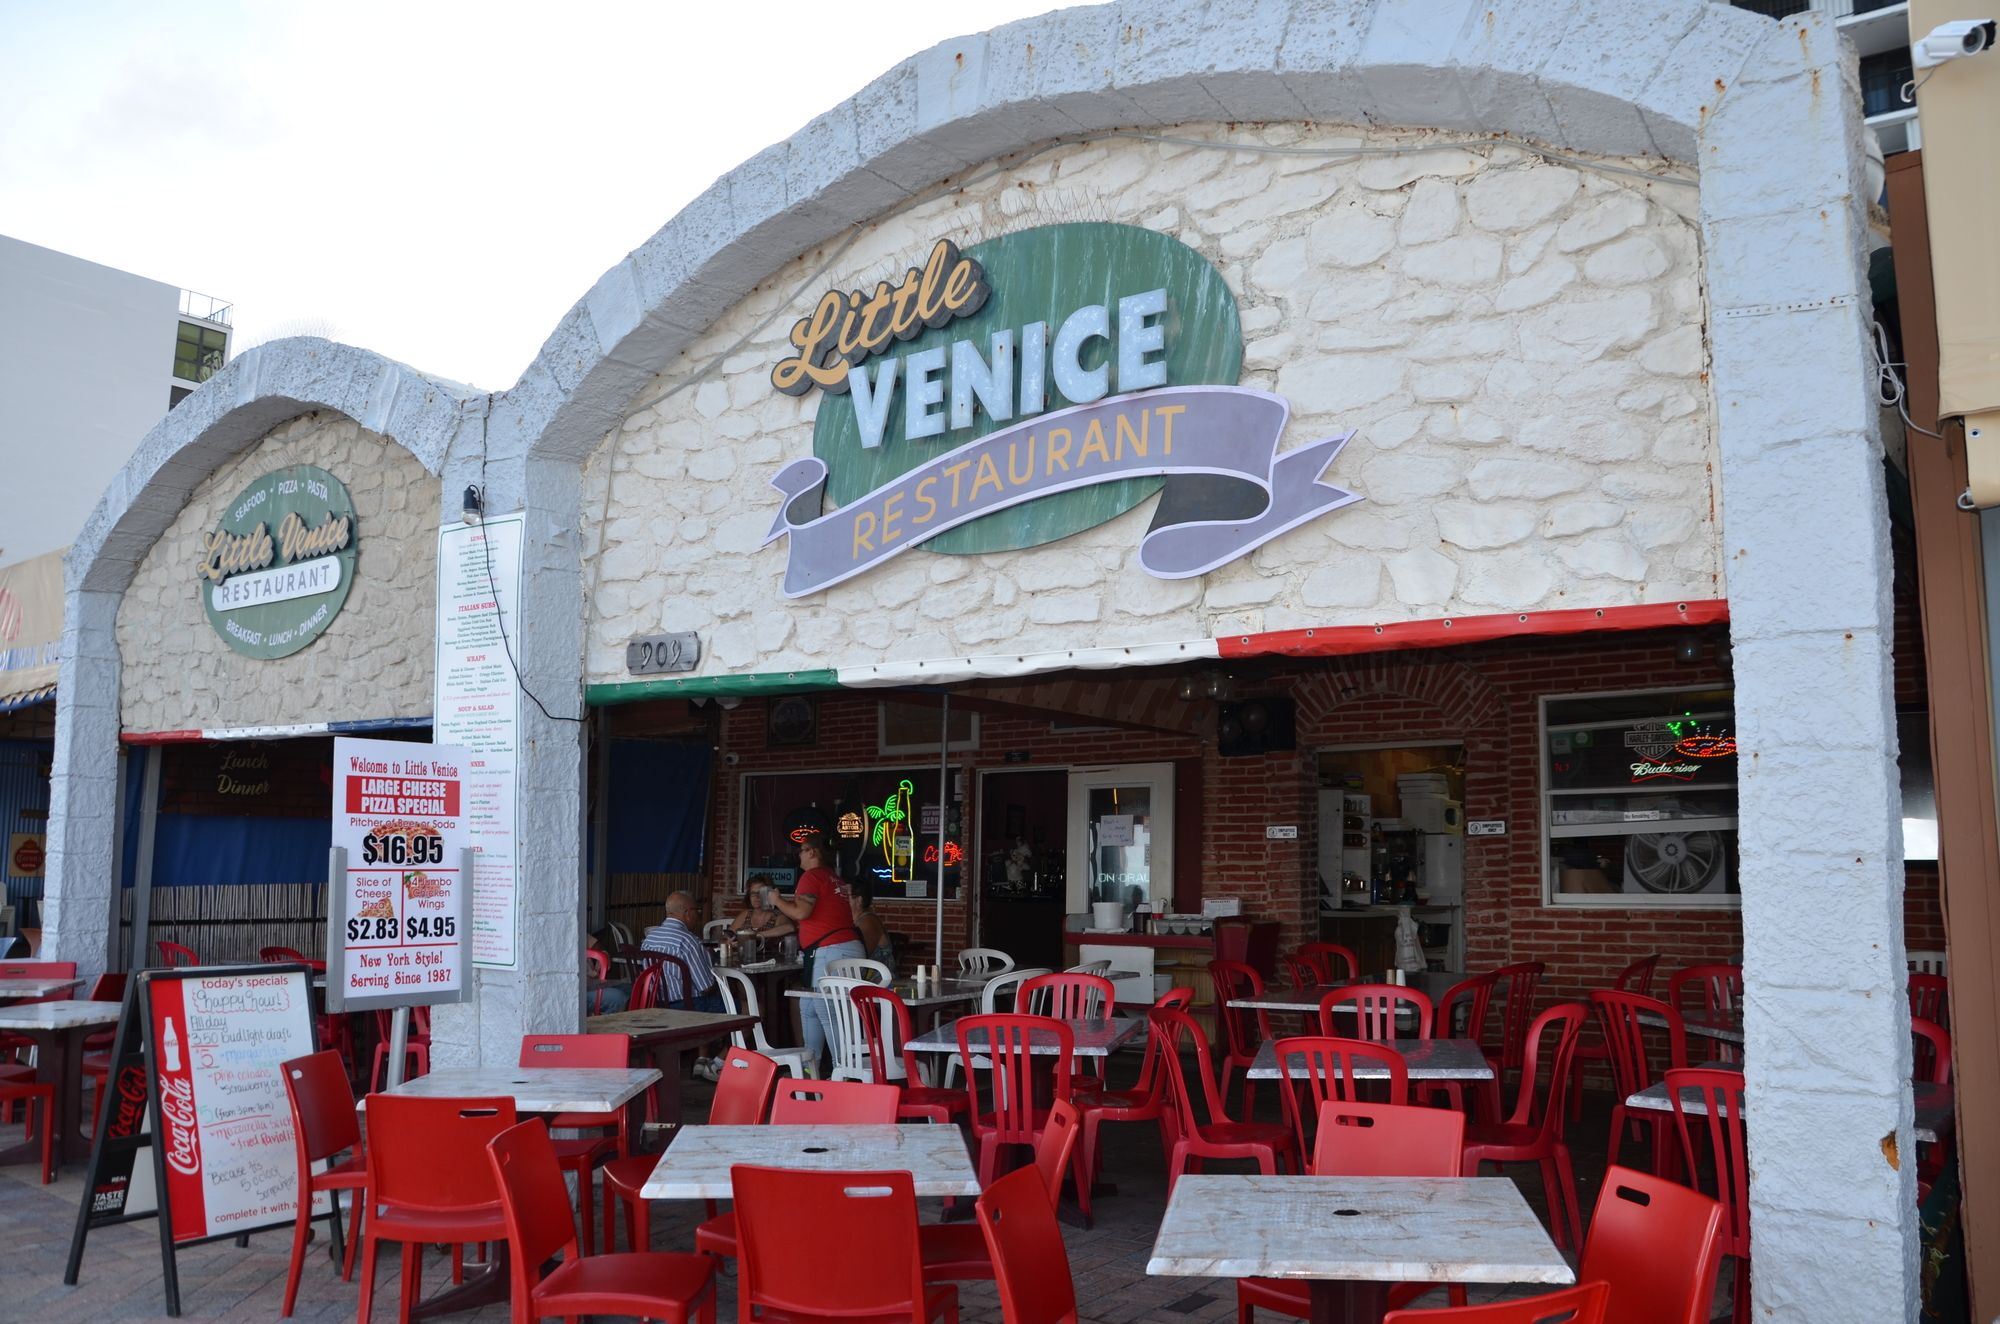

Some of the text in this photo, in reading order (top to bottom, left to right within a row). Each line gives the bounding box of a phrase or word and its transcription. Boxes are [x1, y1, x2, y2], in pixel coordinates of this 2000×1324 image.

[772, 238, 979, 387] Little
[846, 287, 1168, 450] VENICE
[851, 404, 1186, 560] RESTAURANT
[235, 479, 329, 522] SEAFOOD PIZZA PASTA
[197, 511, 350, 582] Little Venice
[221, 564, 331, 604] RESTAURANT
[458, 603, 480, 613] ITALIAN
[226, 603, 328, 647] BREAKFAST LUNCH DINNER
[640, 639, 682, 670] 909
[220, 750, 269, 771] Lunch
[350, 756, 388, 774] Welcome
[392, 760, 401, 775] to
[405, 759, 428, 776] Little
[431, 761, 458, 778] Venice
[217, 773, 271, 796] Dinner
[361, 778, 446, 798] LARGE CHEESE
[361, 796, 446, 815] PIZZA SPECIAL
[350, 817, 383, 827] Pitcher
[385, 817, 396, 828] of
[398, 818, 418, 828] Beer
[432, 819, 456, 829] Soda
[362, 832, 444, 866] $16.95
[356, 876, 392, 887] Slice of
[411, 877, 452, 887] 4 Jumbo
[355, 889, 392, 898] Cheese
[412, 888, 451, 898] Chicken
[362, 900, 386, 910] Pizza
[418, 900, 446, 911] Wings
[347, 918, 399, 942] $2.83
[406, 916, 456, 940] $4.95
[360, 951, 443, 968] New York Style!
[201, 975, 289, 989] today's specials
[350, 969, 451, 990] Serving Since 1987
[160, 1072, 200, 1175] Coca-Cola
[95, 1189, 125, 1200] TASTE
[214, 1208, 258, 1223] complete
[261, 1205, 268, 1215] it
[270, 1204, 290, 1214] with
